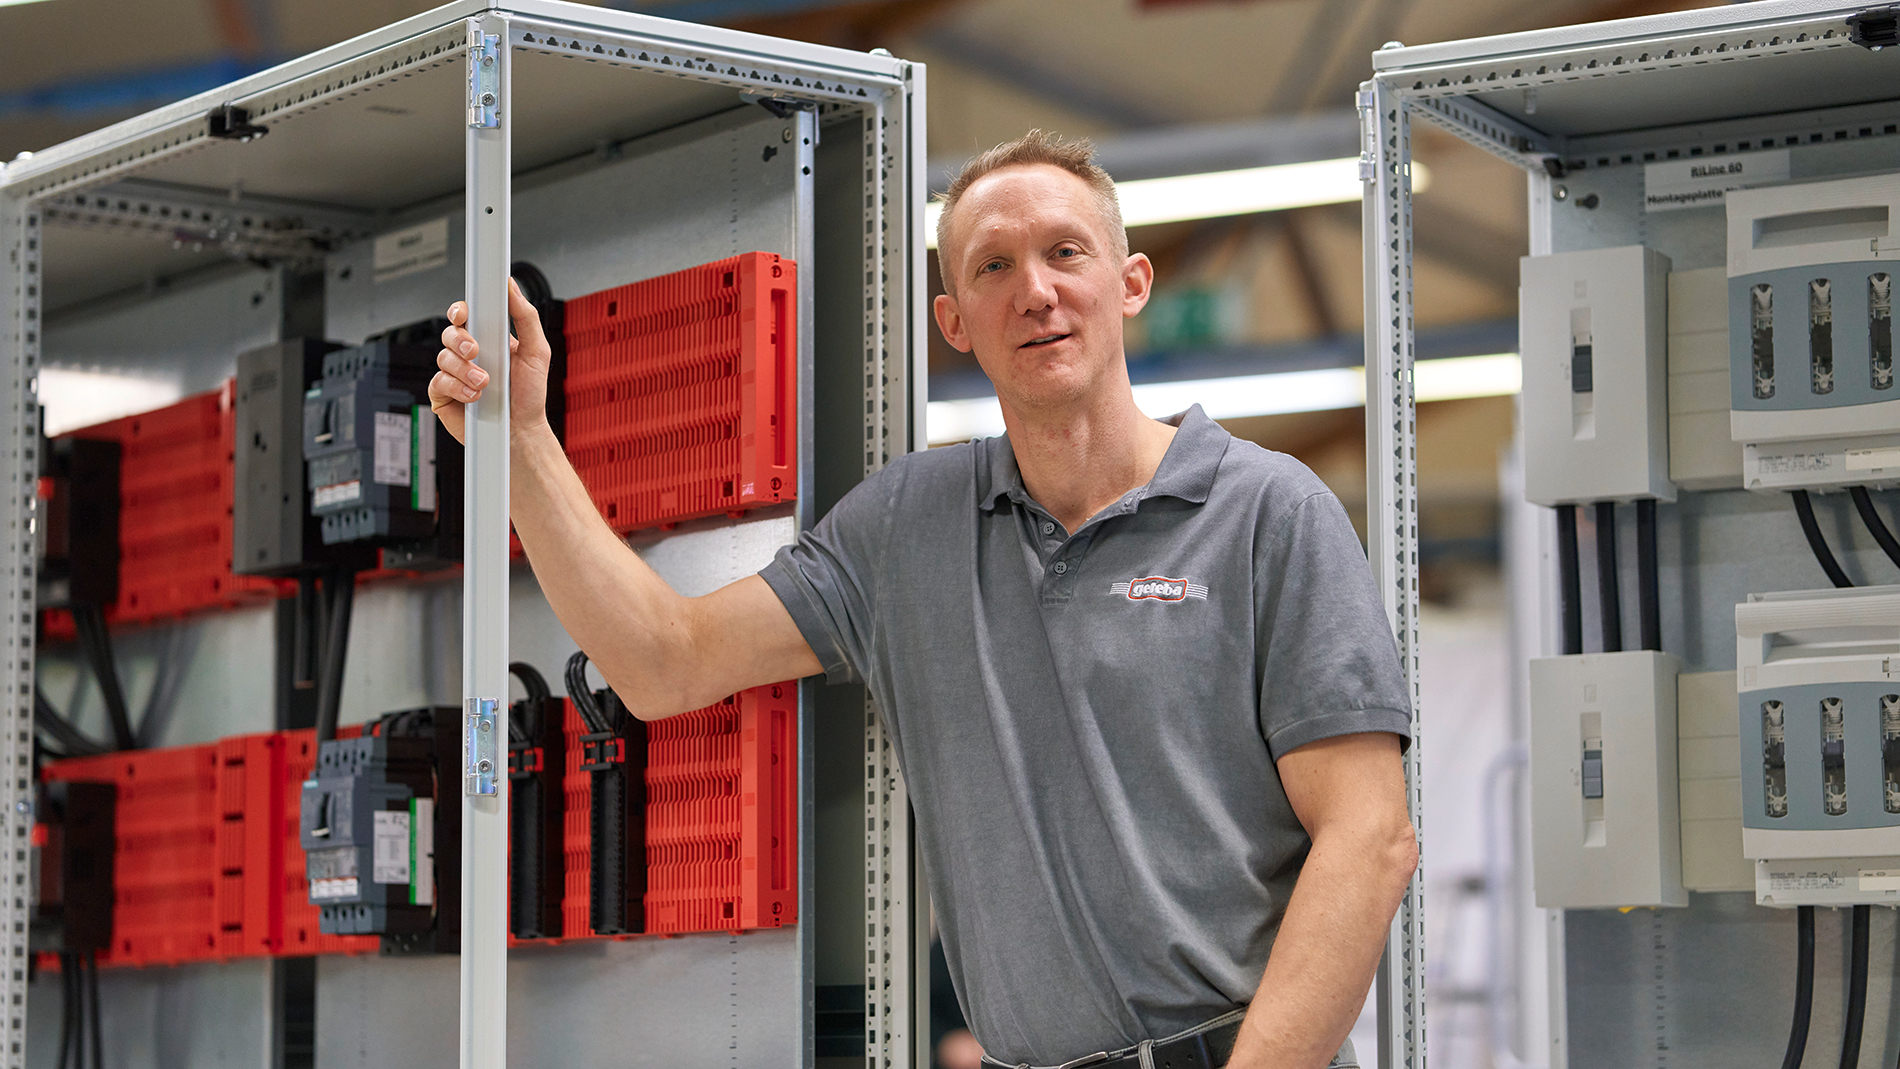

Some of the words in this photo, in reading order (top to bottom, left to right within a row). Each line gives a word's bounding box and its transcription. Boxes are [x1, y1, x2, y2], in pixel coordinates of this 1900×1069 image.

[1690, 163, 1726, 178] RiLine
[1728, 161, 1743, 174] 60
[1646, 188, 1723, 205] Montageplatte
